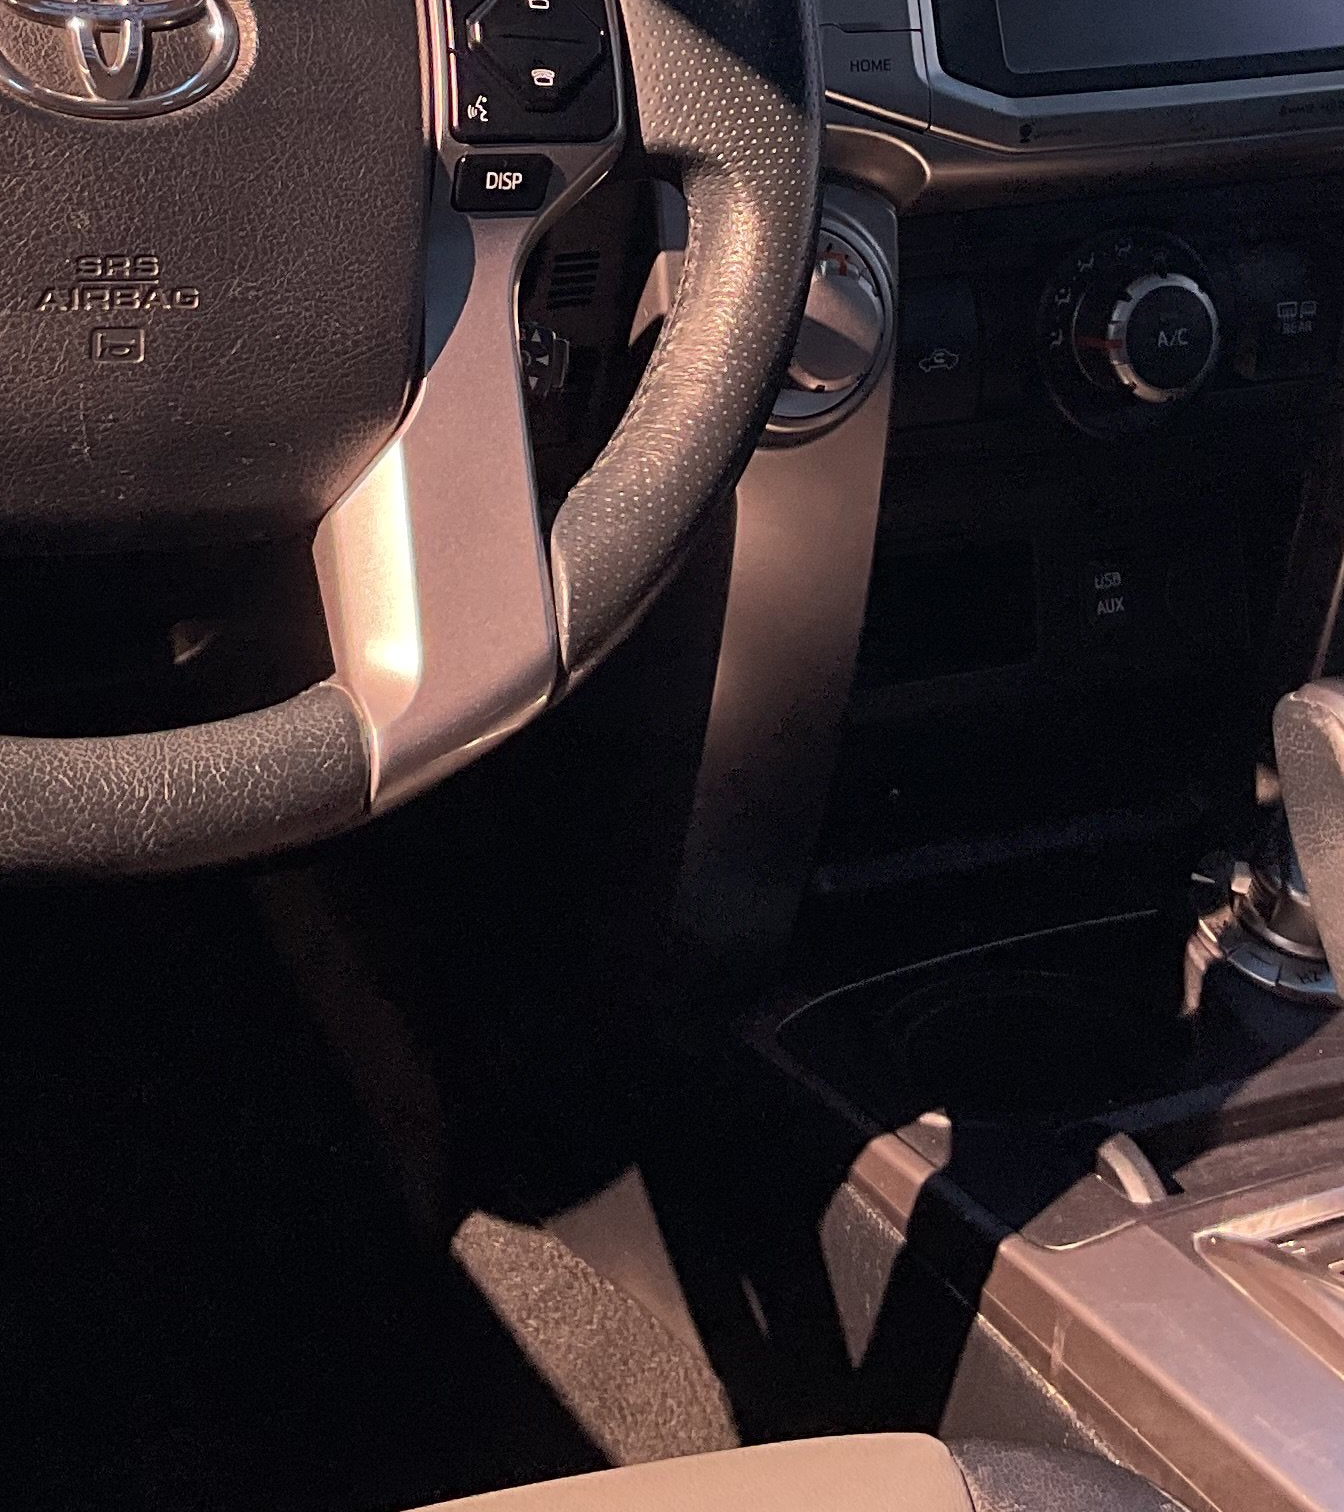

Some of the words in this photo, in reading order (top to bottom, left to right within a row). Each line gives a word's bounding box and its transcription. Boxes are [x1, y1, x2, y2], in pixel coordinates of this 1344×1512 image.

[849, 58, 892, 73] HOME
[485, 171, 523, 190] DISP
[74, 254, 160, 277] SRS
[34, 285, 201, 313] AIRBAG
[1157, 327, 1189, 348] A/C
[1096, 596, 1125, 616] AUX
